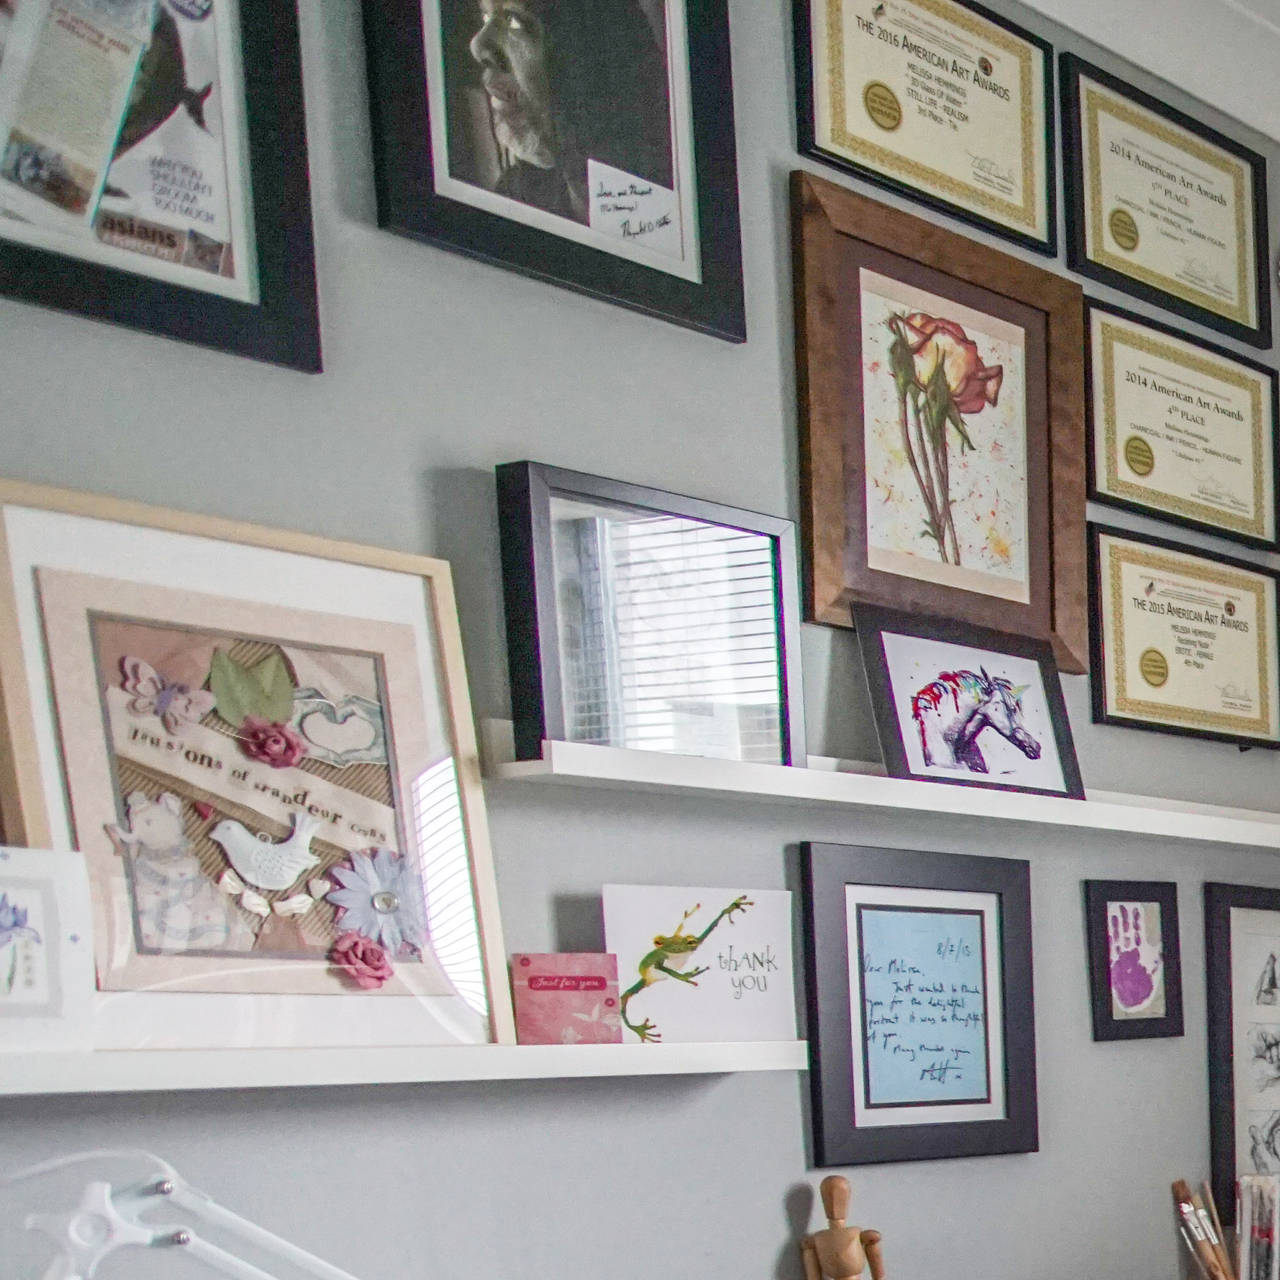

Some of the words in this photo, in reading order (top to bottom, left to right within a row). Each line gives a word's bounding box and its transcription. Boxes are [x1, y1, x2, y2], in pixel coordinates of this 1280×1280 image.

[855, 15, 874, 36] THE
[877, 26, 900, 48] 2016
[1110, 141, 1131, 161] 2014
[1134, 154, 1177, 184] American
[1179, 176, 1194, 190] Art
[1196, 184, 1227, 207] Awards
[1164, 188, 1189, 206] PLACE
[102, 215, 178, 249] asians
[1125, 370, 1148, 388] 2014
[1150, 379, 1194, 404] American
[1196, 396, 1211, 411] Art
[1213, 403, 1244, 423] Awards
[1180, 410, 1206, 427] PLACE
[1132, 597, 1147, 611] THE
[1148, 601, 1166, 615] 2015
[535, 977, 559, 989] Just
[560, 977, 577, 989] for
[578, 979, 600, 990] you
